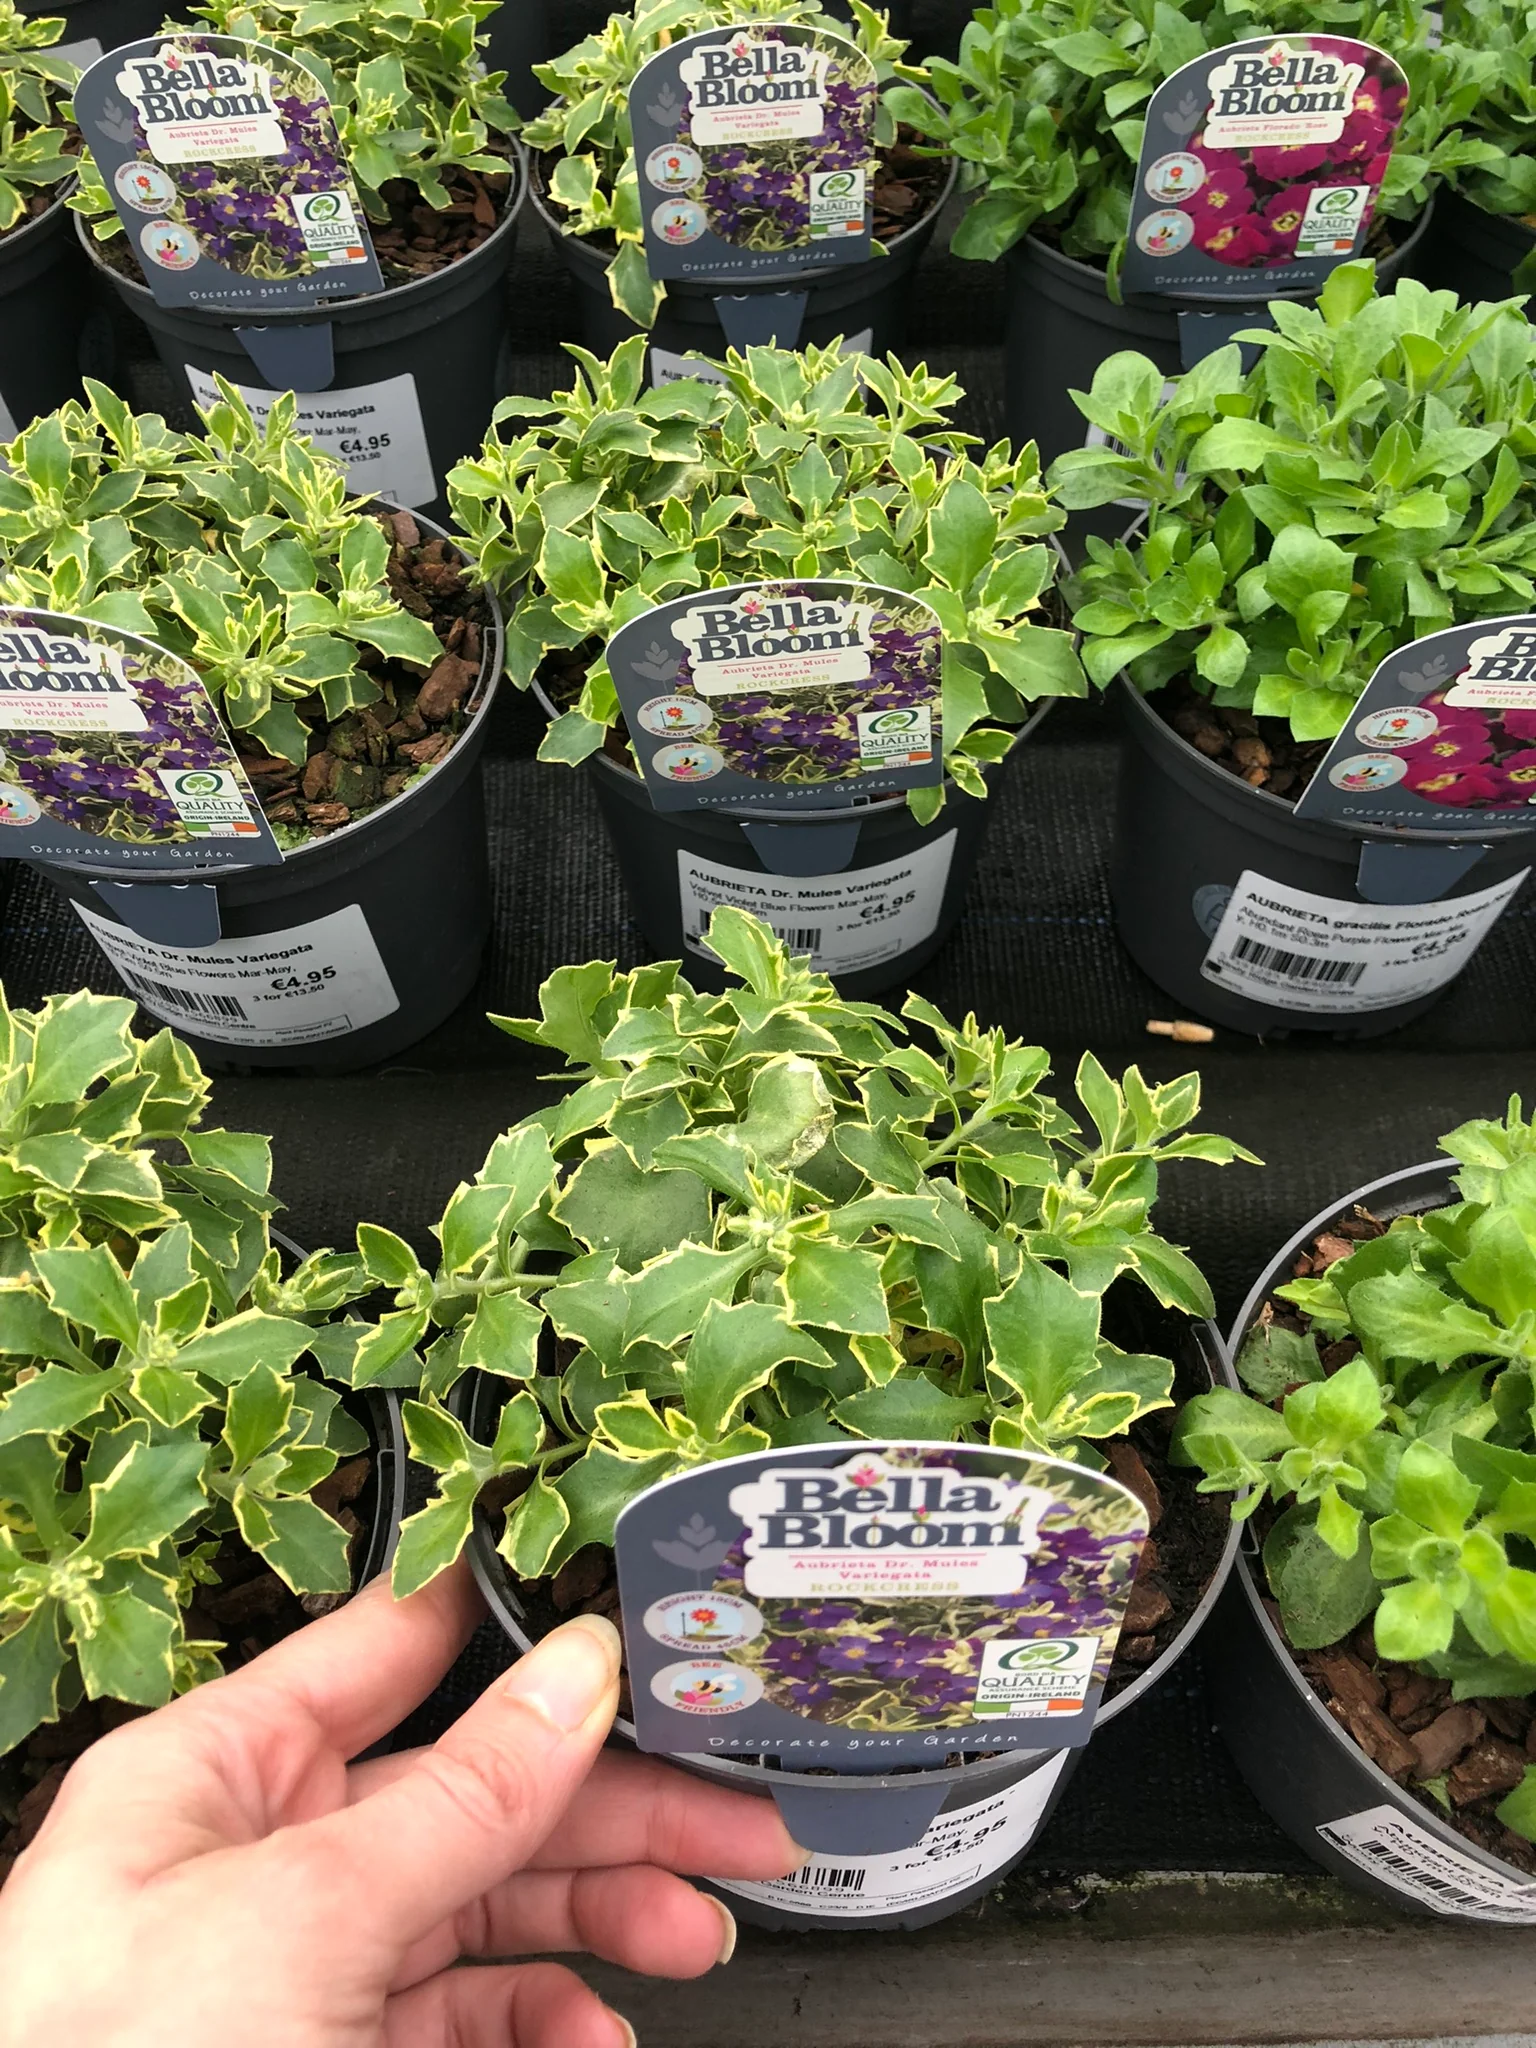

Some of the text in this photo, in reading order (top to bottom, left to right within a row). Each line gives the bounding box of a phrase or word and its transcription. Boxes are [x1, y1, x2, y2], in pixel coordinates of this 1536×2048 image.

[700, 46, 806, 80] Bella
[132, 59, 247, 94] Bella
[1229, 57, 1339, 89] Bella
[694, 79, 820, 108] Bloom
[1215, 87, 1346, 117] Bloom
[136, 91, 271, 123] Bloom
[183, 145, 257, 158] ROCKCRESS
[811, 200, 863, 213] QUALITY
[303, 224, 357, 238] QUALITY
[1303, 218, 1358, 230] QUALITY
[682, 251, 837, 272] Decorate your Garden
[1264, 270, 1316, 280] Garden
[189, 280, 347, 301] Decorate your Garden
[315, 404, 376, 420] Variegata
[340, 433, 391, 454] €4.95
[697, 601, 843, 637] Bella
[0, 633, 91, 665] ella
[692, 627, 864, 663] Bloom
[722, 657, 839, 675] Aubrieta Dr. Mules
[752, 668, 811, 680] Variegata
[0, 667, 127, 693] loom
[736, 673, 831, 690] ROCKCRESS
[643, 697, 674, 713] HEIGHT
[12, 717, 109, 728] ROCKCRESS
[650, 726, 685, 737] SPREAD
[861, 733, 929, 748] QUALITY
[863, 745, 929, 756] ORIGIN-IRELAND
[670, 769, 716, 781] FRIENDLY
[697, 779, 896, 805] Decorate your Garden
[176, 800, 245, 811] QUALITY
[1342, 807, 1424, 818] Decorate
[31, 845, 234, 858] Decorate your Garden
[689, 869, 912, 899] AUBRIETA Dr. Mules Variegata
[725, 894, 758, 908] Violet
[761, 901, 787, 912] Blue
[789, 902, 835, 913] Flowers
[860, 889, 917, 919] €4.95
[1246, 892, 1329, 926] AUBRIETA
[1239, 905, 1295, 932] Abundant
[1297, 925, 1329, 941] Rose
[1331, 932, 1372, 946] Purple
[162, 952, 185, 962] Dr.
[187, 954, 235, 965] Mules
[237, 943, 314, 963] Variegata
[160, 960, 187, 974] Blue
[188, 966, 236, 979] Flowers
[271, 965, 338, 990] €4.95
[263, 993, 282, 1001] for
[284, 983, 325, 998] €13.50
[776, 1476, 1002, 1514] Bella
[758, 1513, 1025, 1549] Bloom
[793, 1558, 979, 1570] Aubrieta Dr. Mules
[839, 1570, 932, 1581] Variegata
[810, 1581, 960, 1593] ROCKCRESS
[659, 1633, 712, 1651] SPREAD
[981, 1674, 1087, 1688] QUALITY
[981, 1691, 1082, 1700] ORIGIN-IRELAND
[674, 1700, 745, 1714] FRIENDLY
[708, 1733, 1019, 1749] Decorate your Garden
[927, 1800, 1005, 1833] ariegata
[925, 1816, 1008, 1857] €4.95
[905, 1859, 929, 1870] for
[933, 1839, 985, 1862] €13.50
[1389, 1821, 1505, 1889] AUBRIETA
[817, 1891, 865, 1899] Centre
